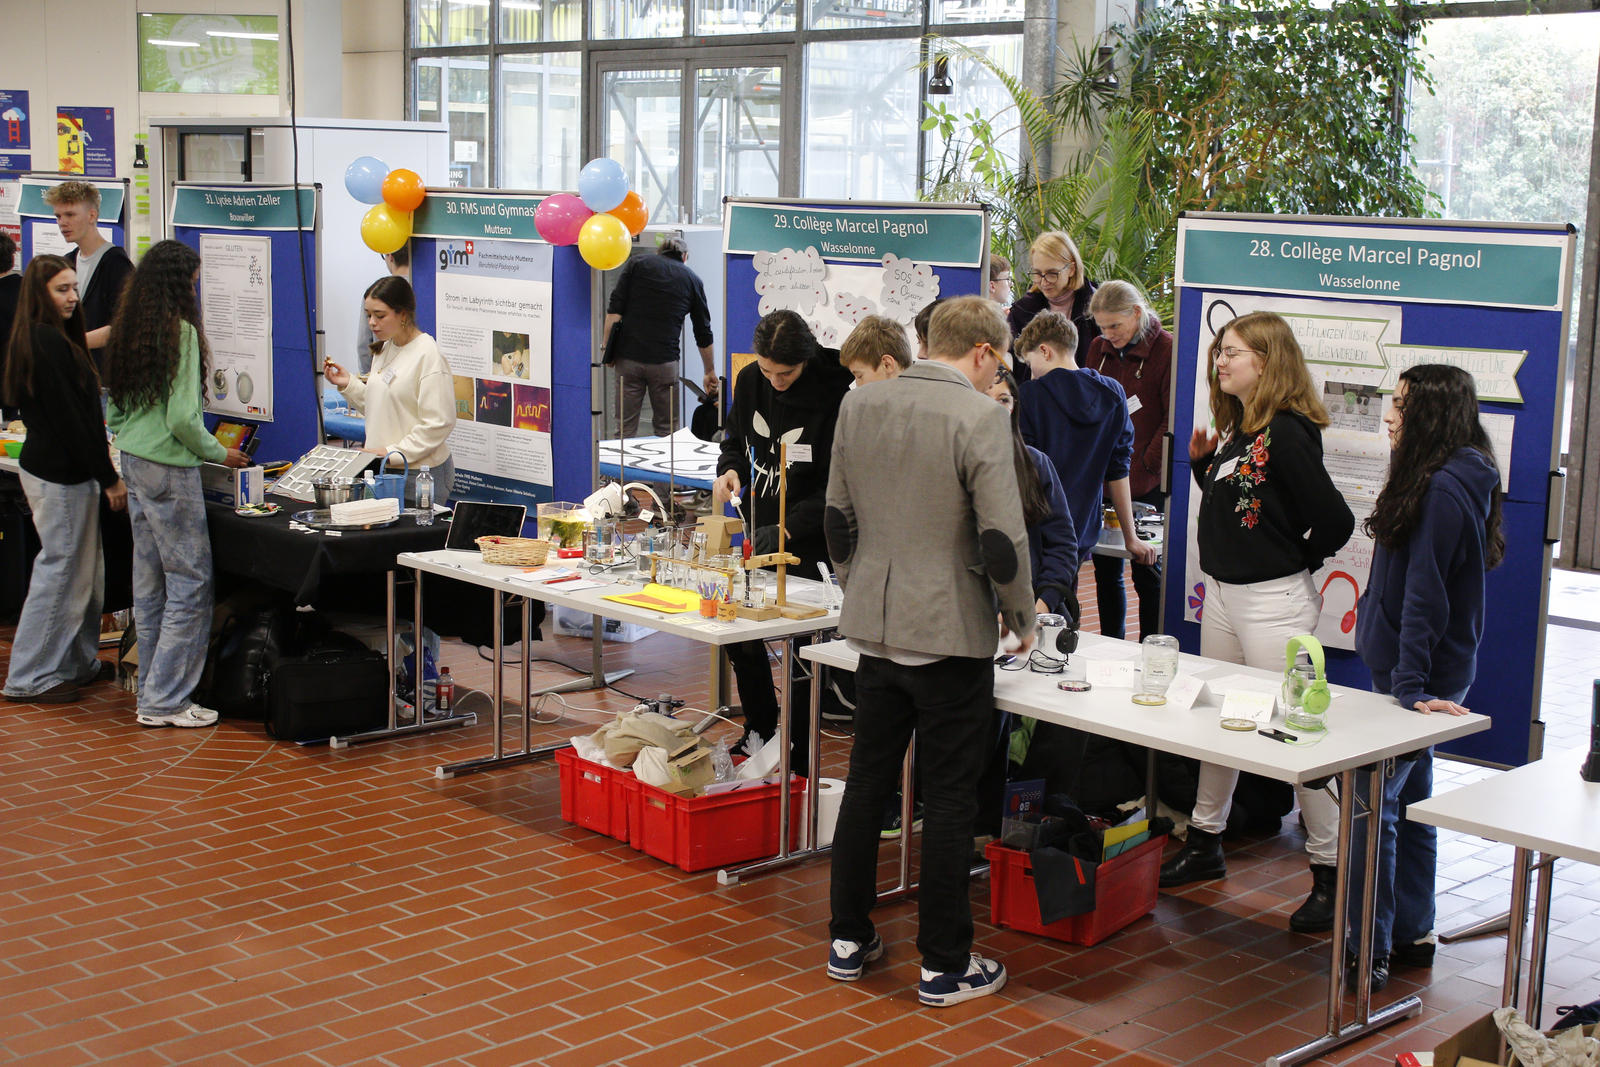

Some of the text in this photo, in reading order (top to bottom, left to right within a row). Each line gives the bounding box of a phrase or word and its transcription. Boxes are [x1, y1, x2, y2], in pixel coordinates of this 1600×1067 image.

[449, 171, 463, 179] ING
[205, 194, 281, 207] 31. Lycée Adrien Zeller
[229, 213, 255, 222] Bouxwiller
[446, 202, 537, 219] 30. FMS und Gymnasi
[484, 224, 512, 235] Muttenz
[774, 214, 929, 238] 29. Collège Marcel Pagnol
[225, 244, 243, 252] GLUTEN
[821, 241, 876, 255] Wasselonne
[478, 252, 534, 263] Fachmittelschule Muttenz
[1249, 239, 1482, 272] 28. Collège Marcel Pagnol
[478, 261, 499, 270] Berufsfeld
[894, 269, 912, 284] SOS
[1318, 272, 1401, 291] Wasselonne
[445, 292, 543, 311] Strom im Labyrinth sichtbar gemacht
[1489, 354, 1507, 374] UNE
[1340, 541, 1375, 556] nclusi
